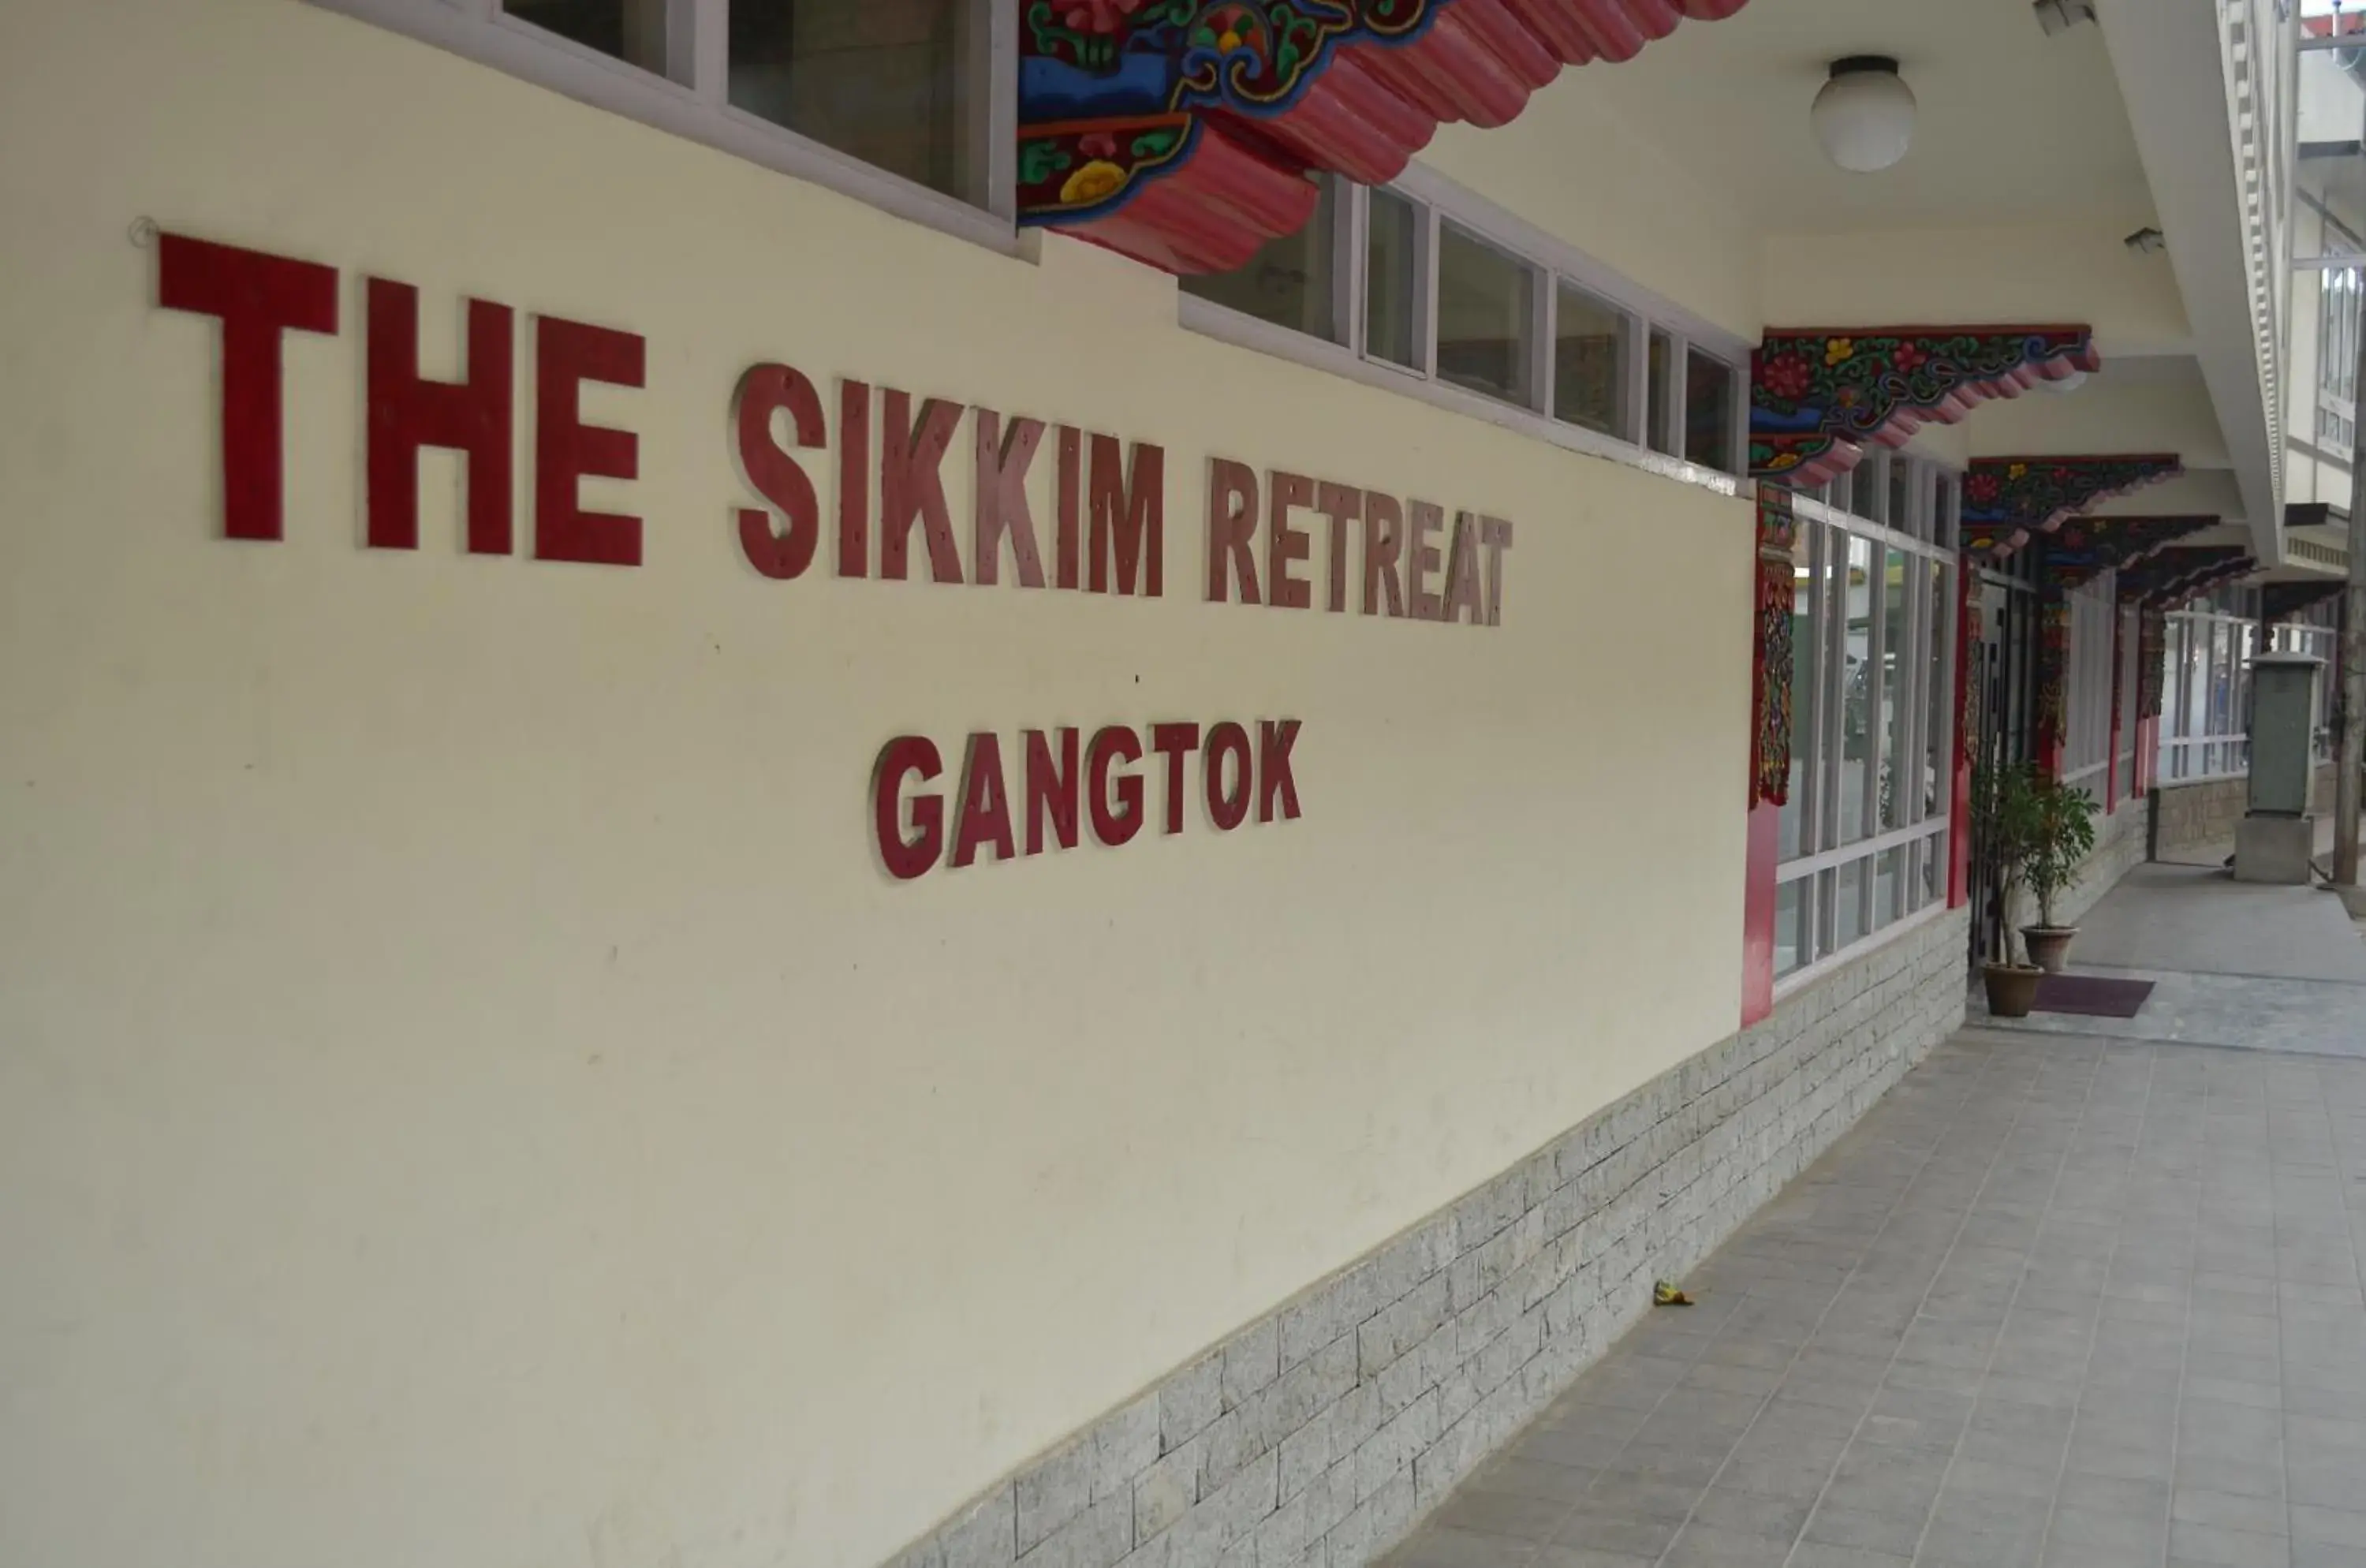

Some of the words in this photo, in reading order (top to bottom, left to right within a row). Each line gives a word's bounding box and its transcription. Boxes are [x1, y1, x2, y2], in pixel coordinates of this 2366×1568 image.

[159, 234, 646, 566] THE
[735, 362, 1164, 597] SIKKIM
[1208, 456, 1513, 626] RETREAT
[874, 719, 1302, 879] GANGTOK
